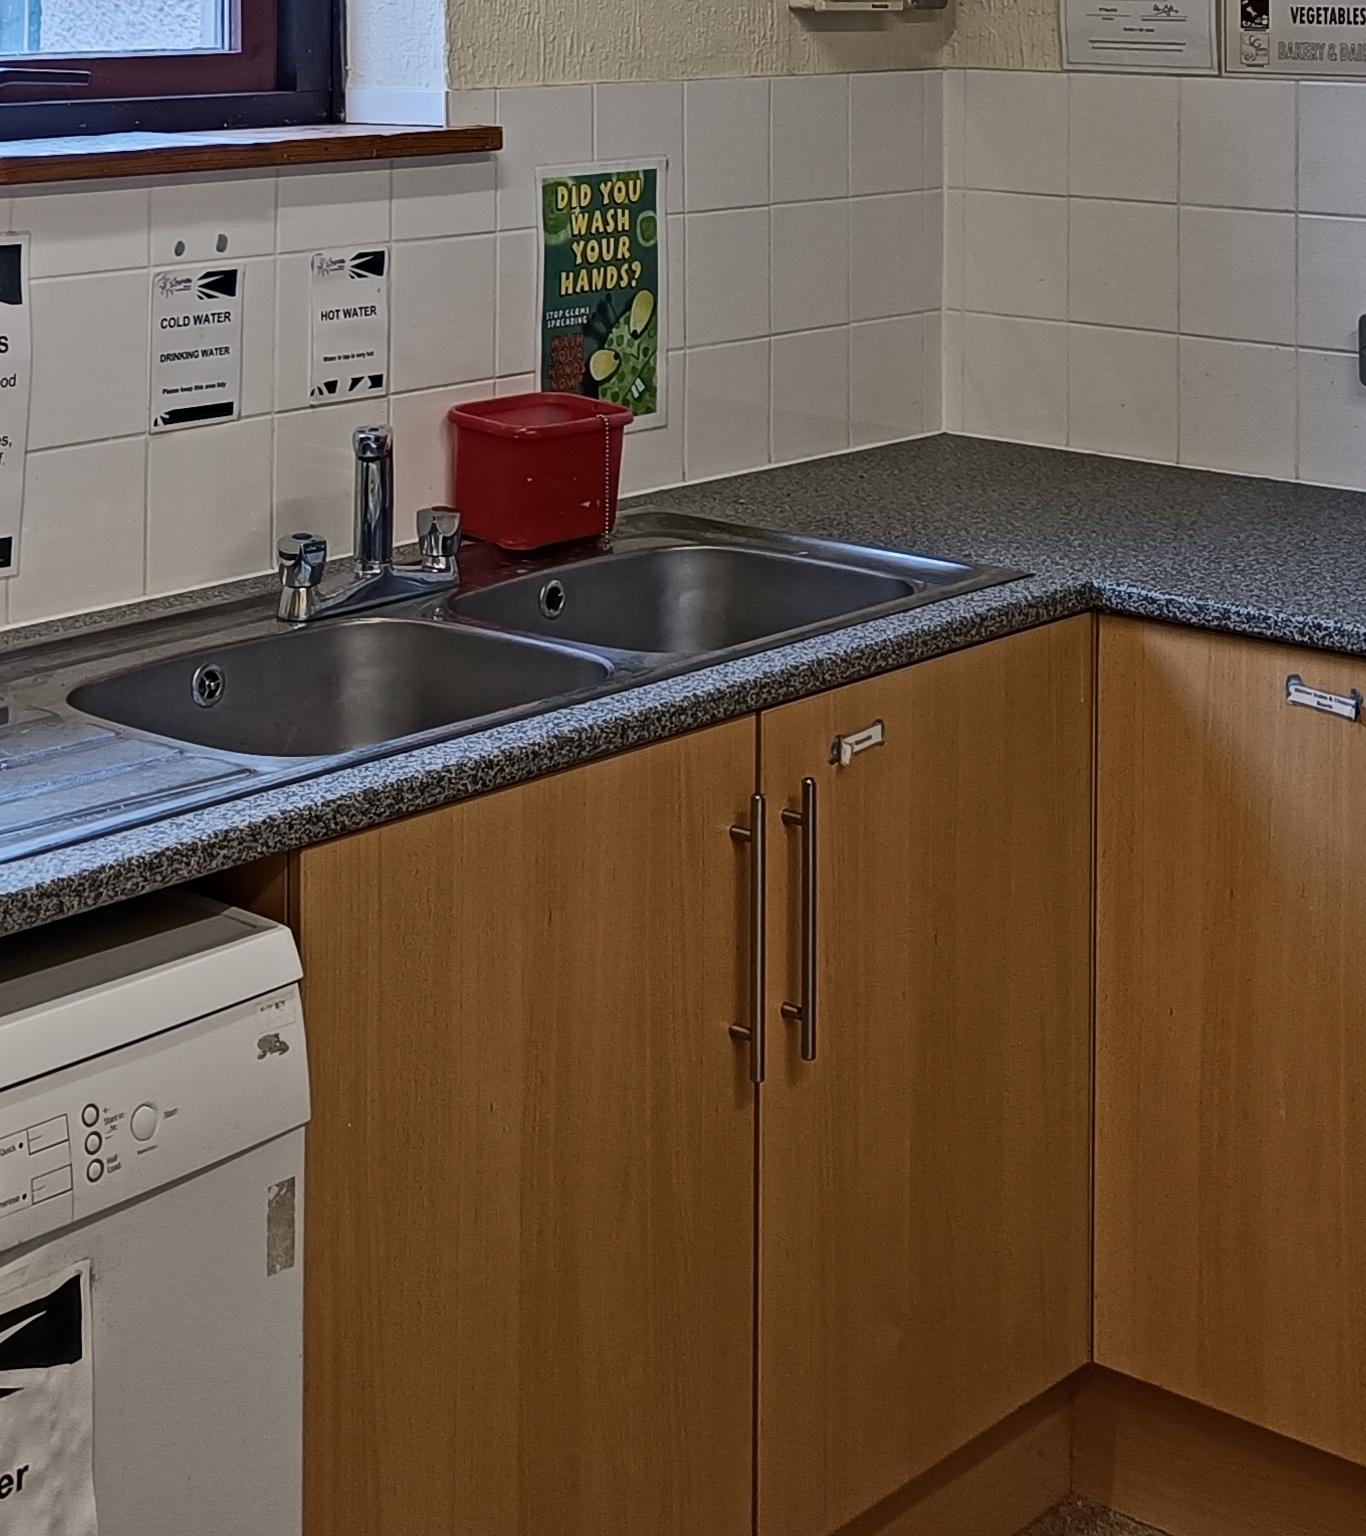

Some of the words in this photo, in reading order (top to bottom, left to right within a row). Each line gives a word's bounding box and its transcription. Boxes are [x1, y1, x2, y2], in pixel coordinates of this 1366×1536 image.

[1290, 7, 1366, 26] VEGETABLES
[1278, 42, 1324, 61] BAKERY
[1327, 43, 1338, 61] &
[557, 184, 593, 211] DID
[600, 180, 641, 205] YOU
[572, 209, 630, 236] WASH
[573, 237, 630, 264] YOUR
[561, 262, 642, 295] HANDS?
[160, 314, 190, 329] COLD
[193, 311, 232, 327] WATER
[320, 308, 341, 322] HOT
[342, 305, 378, 319] WATER
[546, 309, 564, 321] STOP
[565, 306, 590, 319] GERMS
[546, 315, 588, 329] SPREADING
[160, 349, 199, 363] DRINKING
[201, 346, 230, 358] WATER
